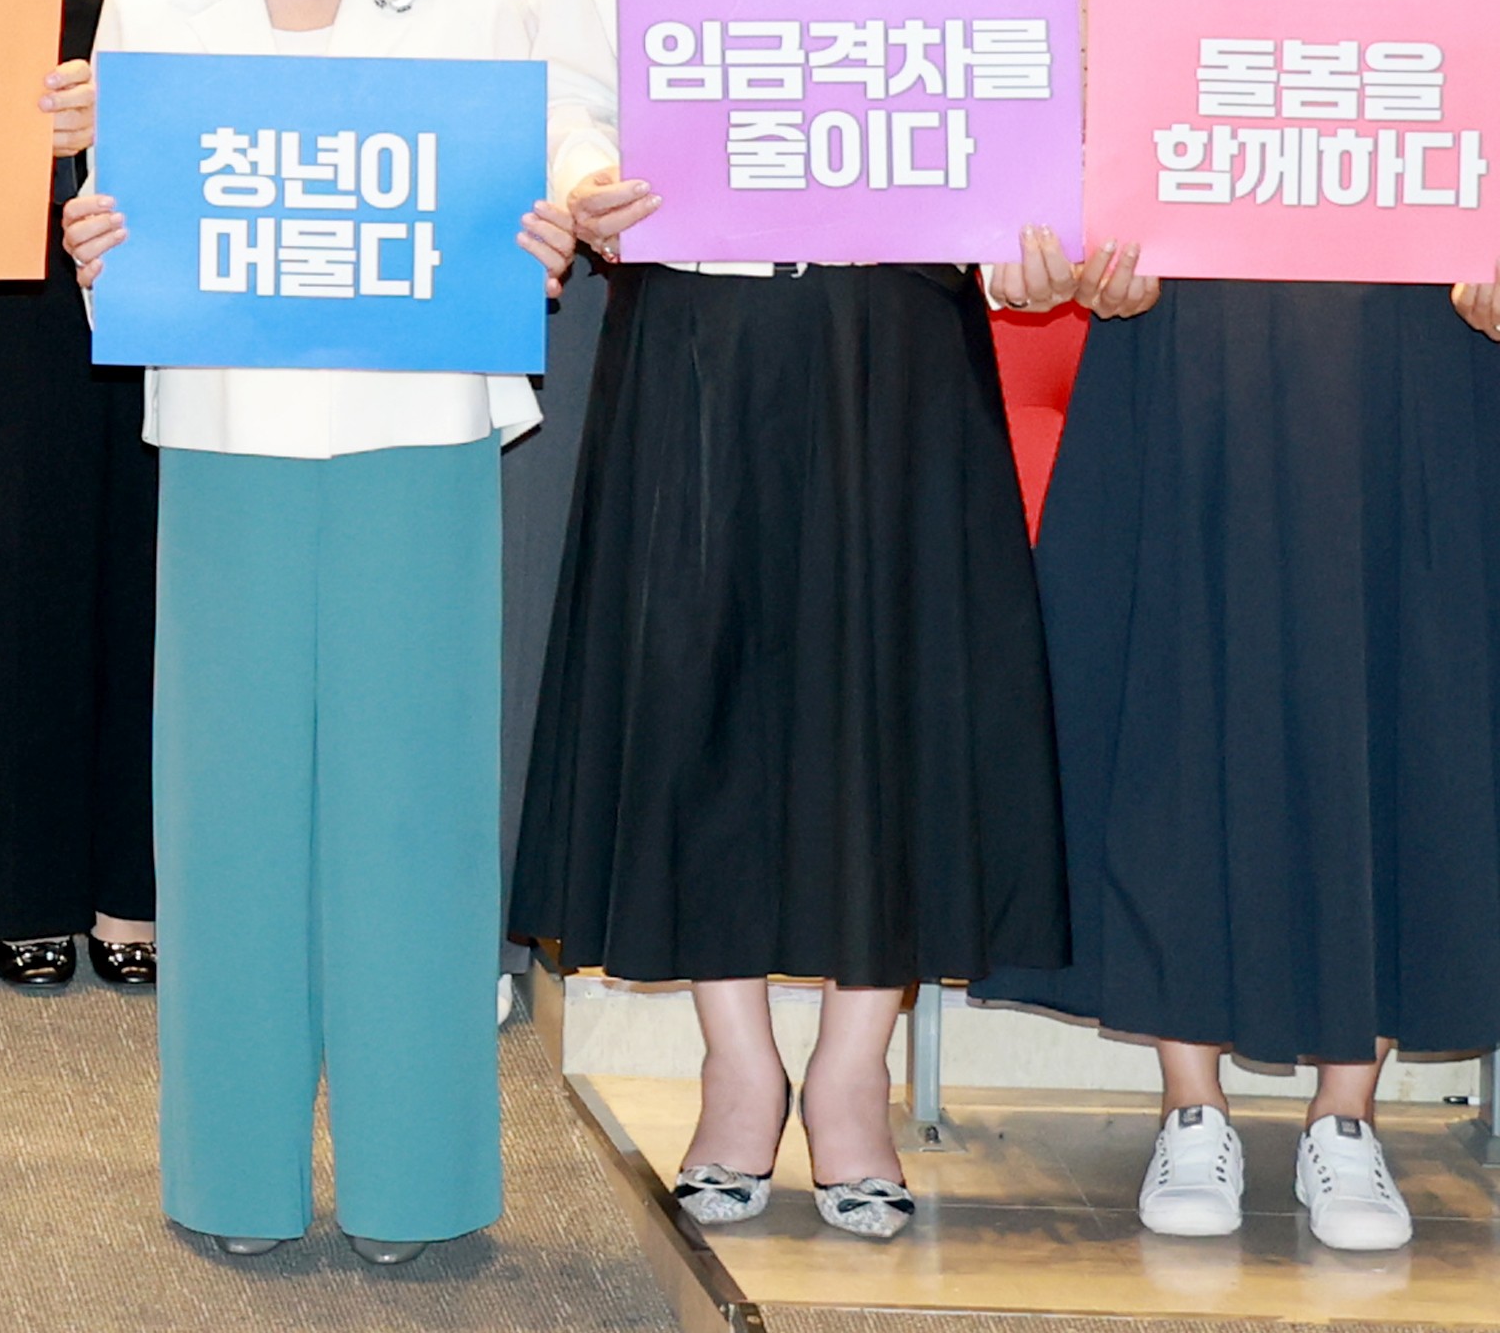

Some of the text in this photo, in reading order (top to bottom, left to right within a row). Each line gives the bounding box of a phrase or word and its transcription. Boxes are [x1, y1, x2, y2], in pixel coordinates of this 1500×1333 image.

[646, 20, 1050, 99] 임금격차를
[1198, 39, 1443, 120] 돌봄을
[200, 128, 436, 210] 청년이
[728, 110, 974, 188] 줄이다
[1154, 124, 1487, 207] 함께하다
[200, 218, 440, 298] 머물다
